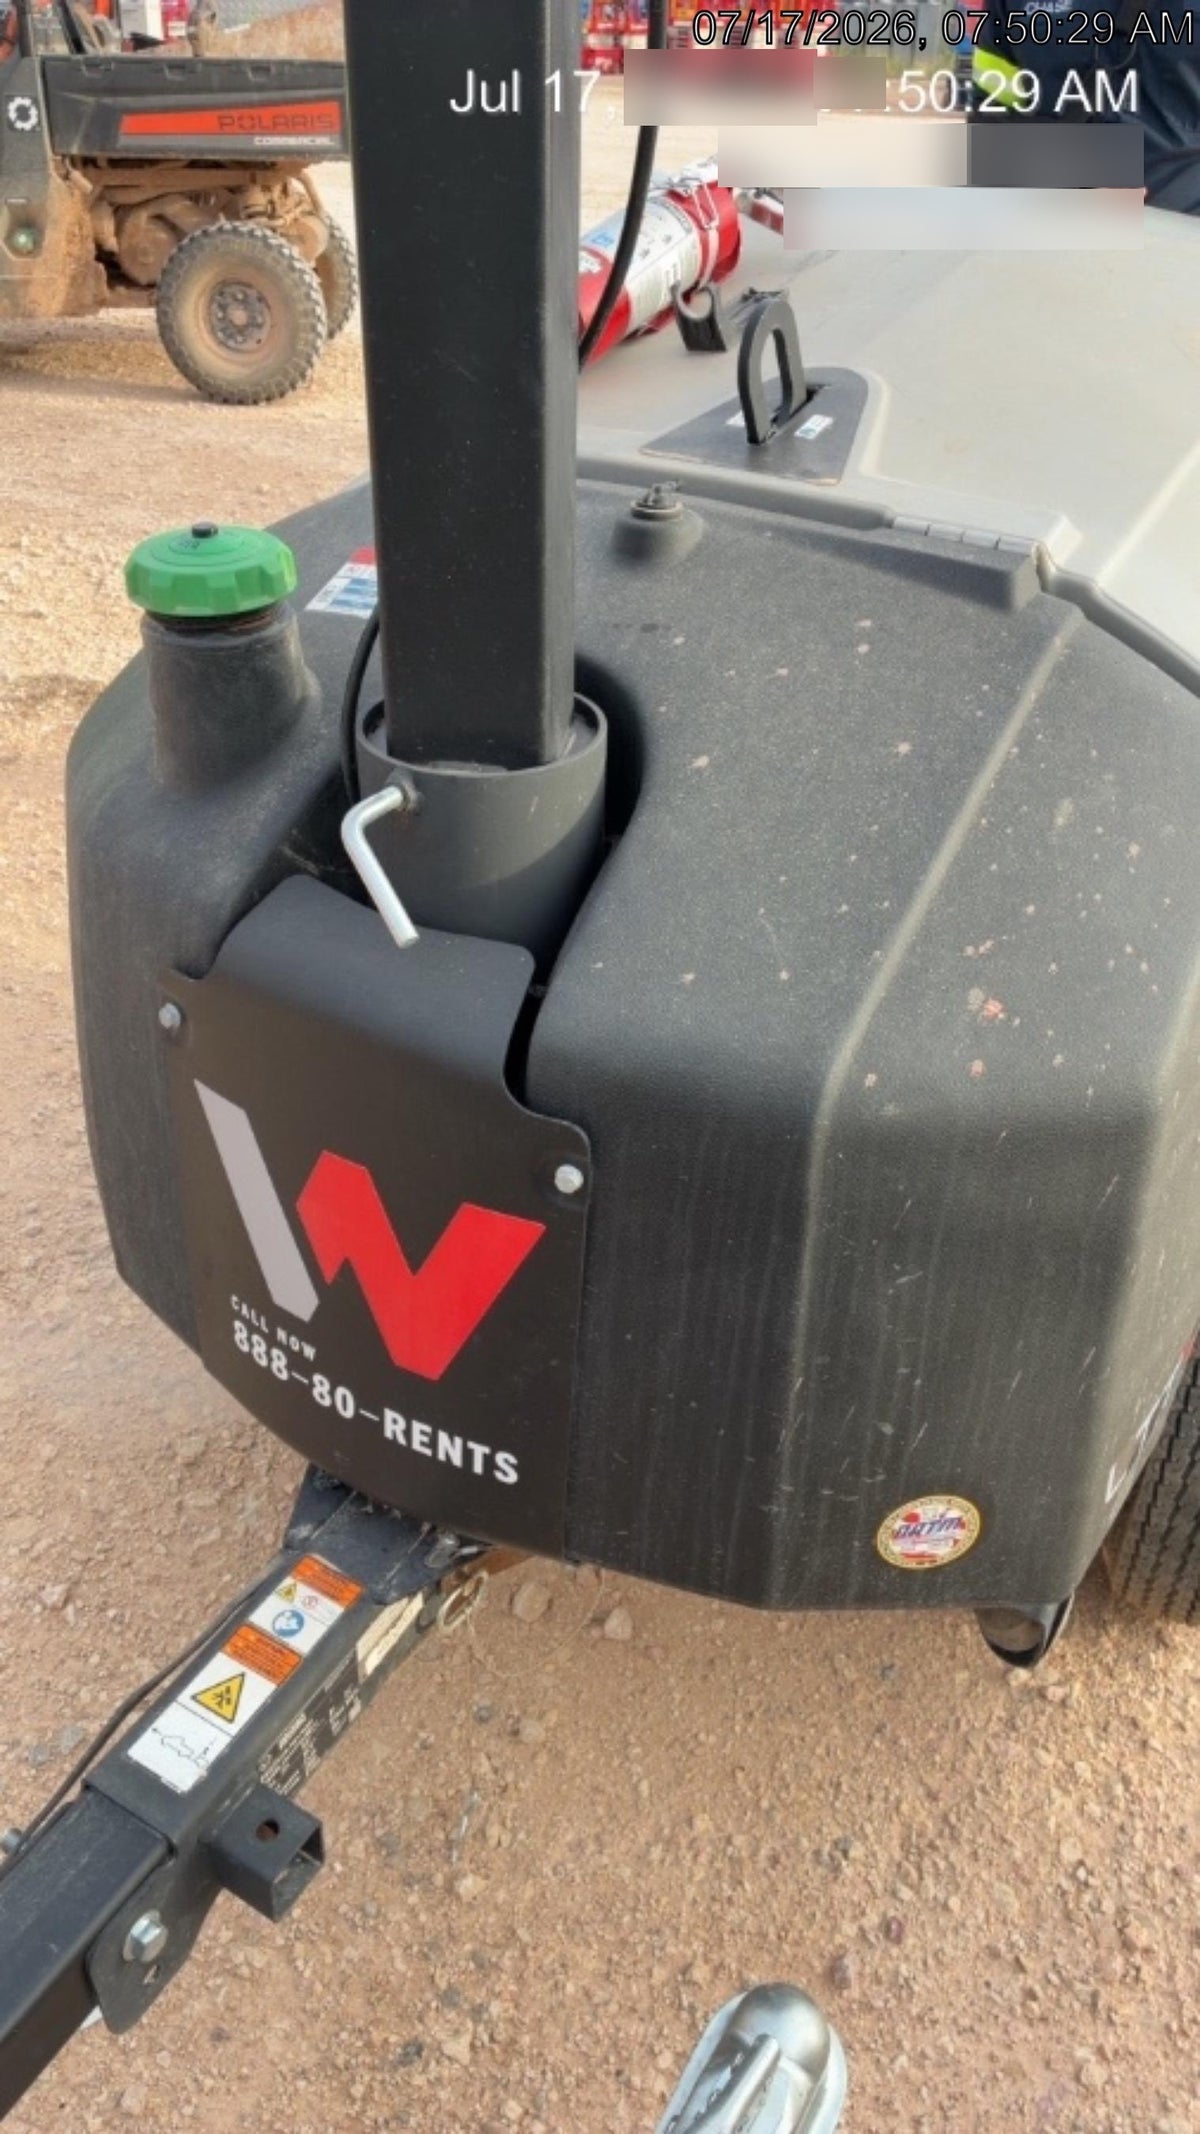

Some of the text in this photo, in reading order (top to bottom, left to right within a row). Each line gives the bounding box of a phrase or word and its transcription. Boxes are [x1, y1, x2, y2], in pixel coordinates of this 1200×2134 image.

[217, 112, 335, 132] POLARIS
[230, 1294, 317, 1362] CALL NOW
[233, 1319, 519, 1485] 888-80-RENTS
